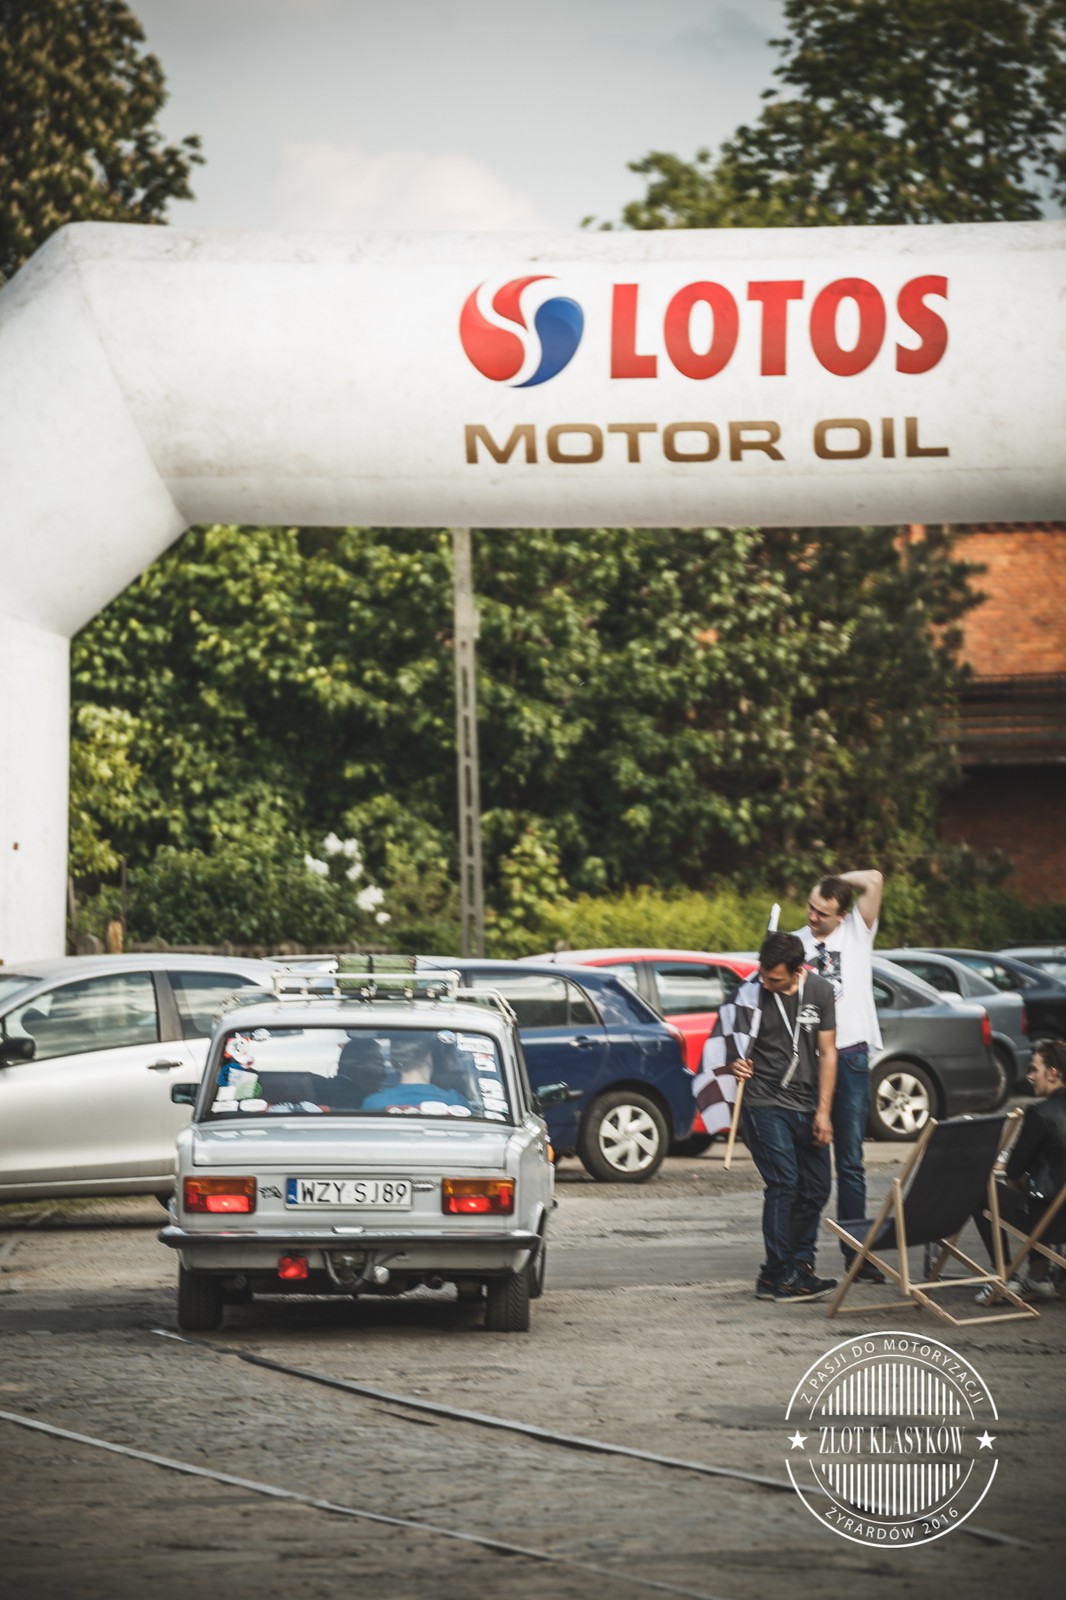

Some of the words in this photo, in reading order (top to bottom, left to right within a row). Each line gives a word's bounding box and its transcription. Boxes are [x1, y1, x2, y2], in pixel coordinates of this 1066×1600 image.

[610, 274, 949, 380] LOTOS
[464, 420, 786, 464] MOTOR
[813, 416, 950, 460] OIL
[301, 1182, 345, 1203] WZY
[354, 1182, 407, 1204] SJ89
